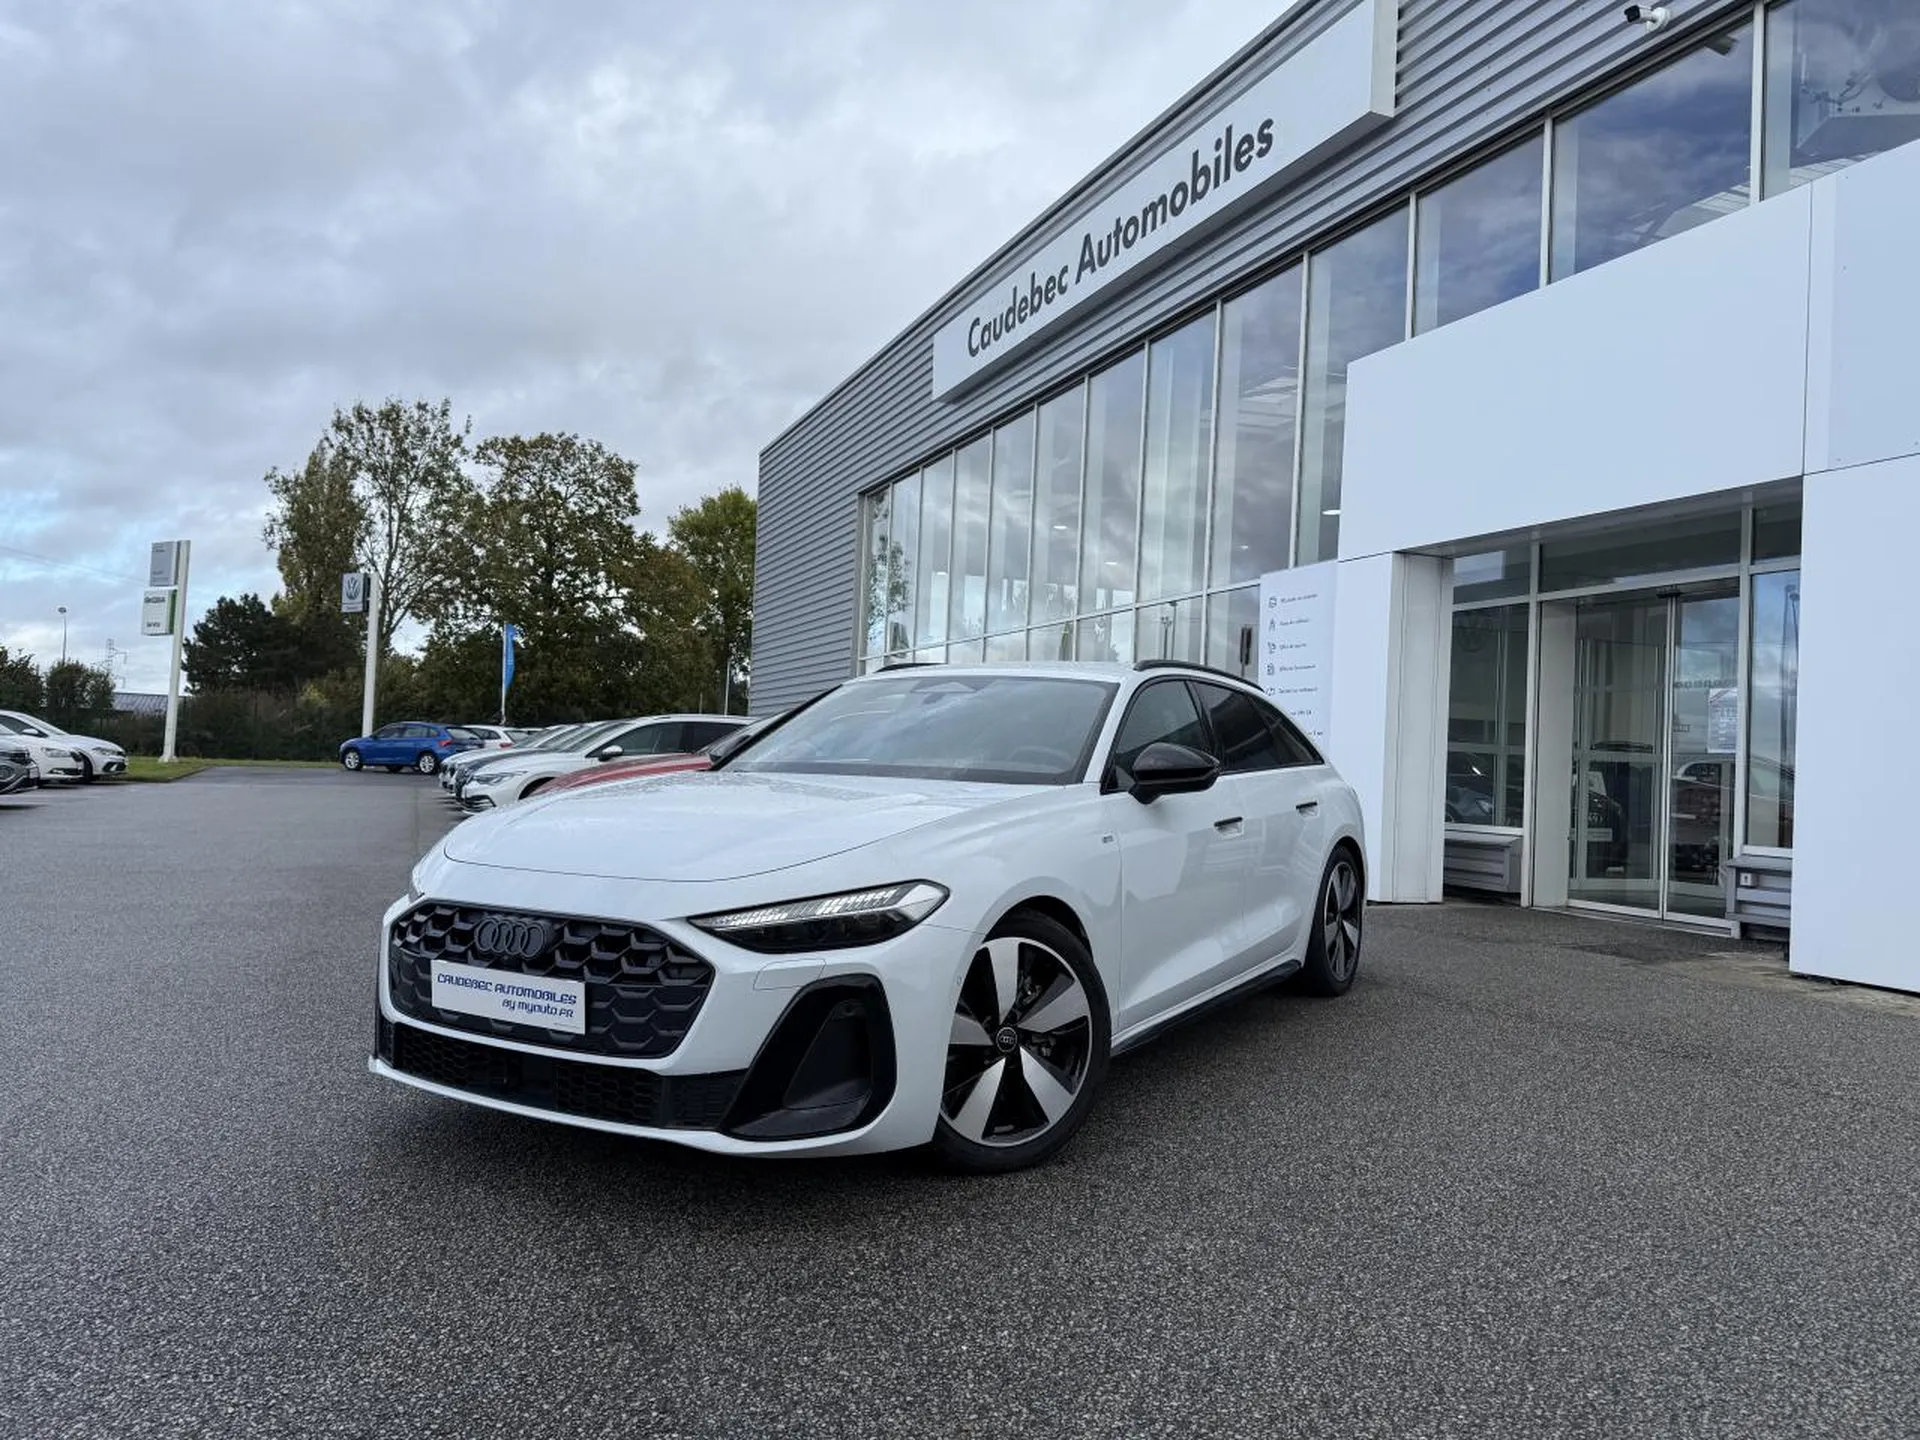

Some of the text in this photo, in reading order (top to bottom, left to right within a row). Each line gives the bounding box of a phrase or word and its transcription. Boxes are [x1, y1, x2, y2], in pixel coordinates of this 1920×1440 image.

[967, 118, 1274, 358] Caudebec Automobiles
[437, 973, 577, 1004] CAUDEBEC AUTOMOBILES
